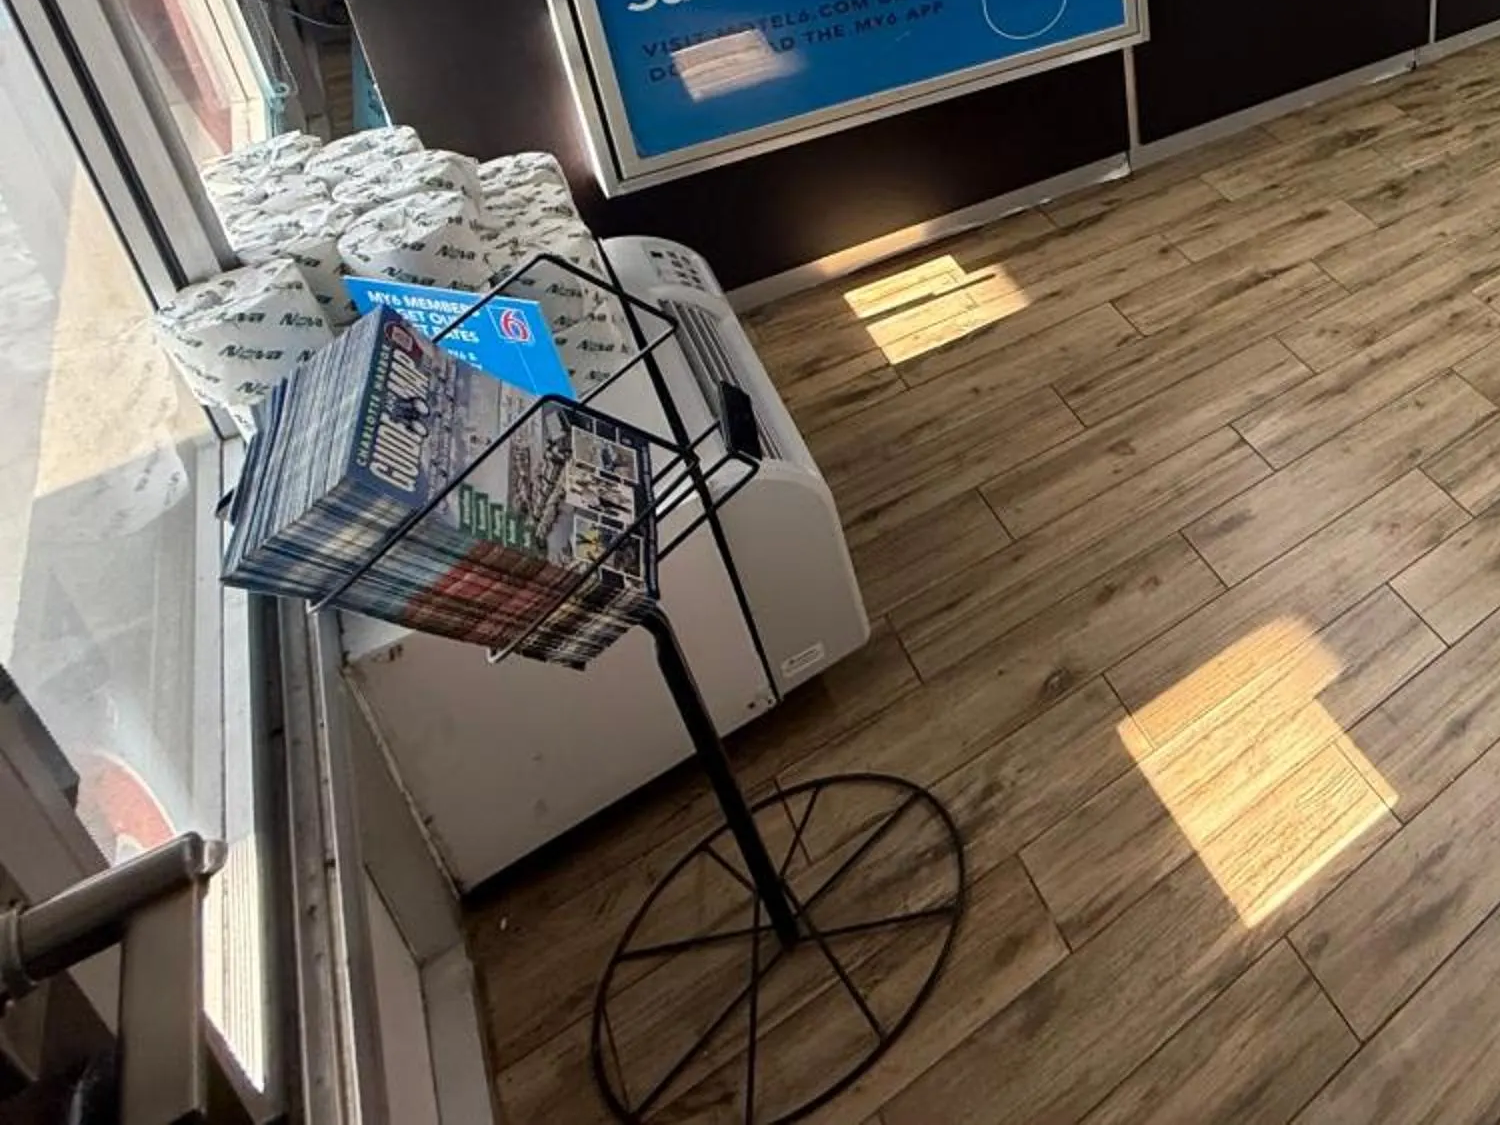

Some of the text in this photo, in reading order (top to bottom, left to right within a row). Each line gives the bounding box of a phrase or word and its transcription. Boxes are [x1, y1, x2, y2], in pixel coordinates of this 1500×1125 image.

[806, 25, 844, 46] THE
[855, 13, 897, 33] MY6
[907, 0, 944, 21] APP
[435, 244, 476, 261] Nova
[501, 309, 531, 343] 6
[218, 344, 284, 360] Nova
[387, 348, 430, 400] MAP
[356, 394, 381, 467] CHARLOTTE
[369, 412, 424, 492] GUIDE
